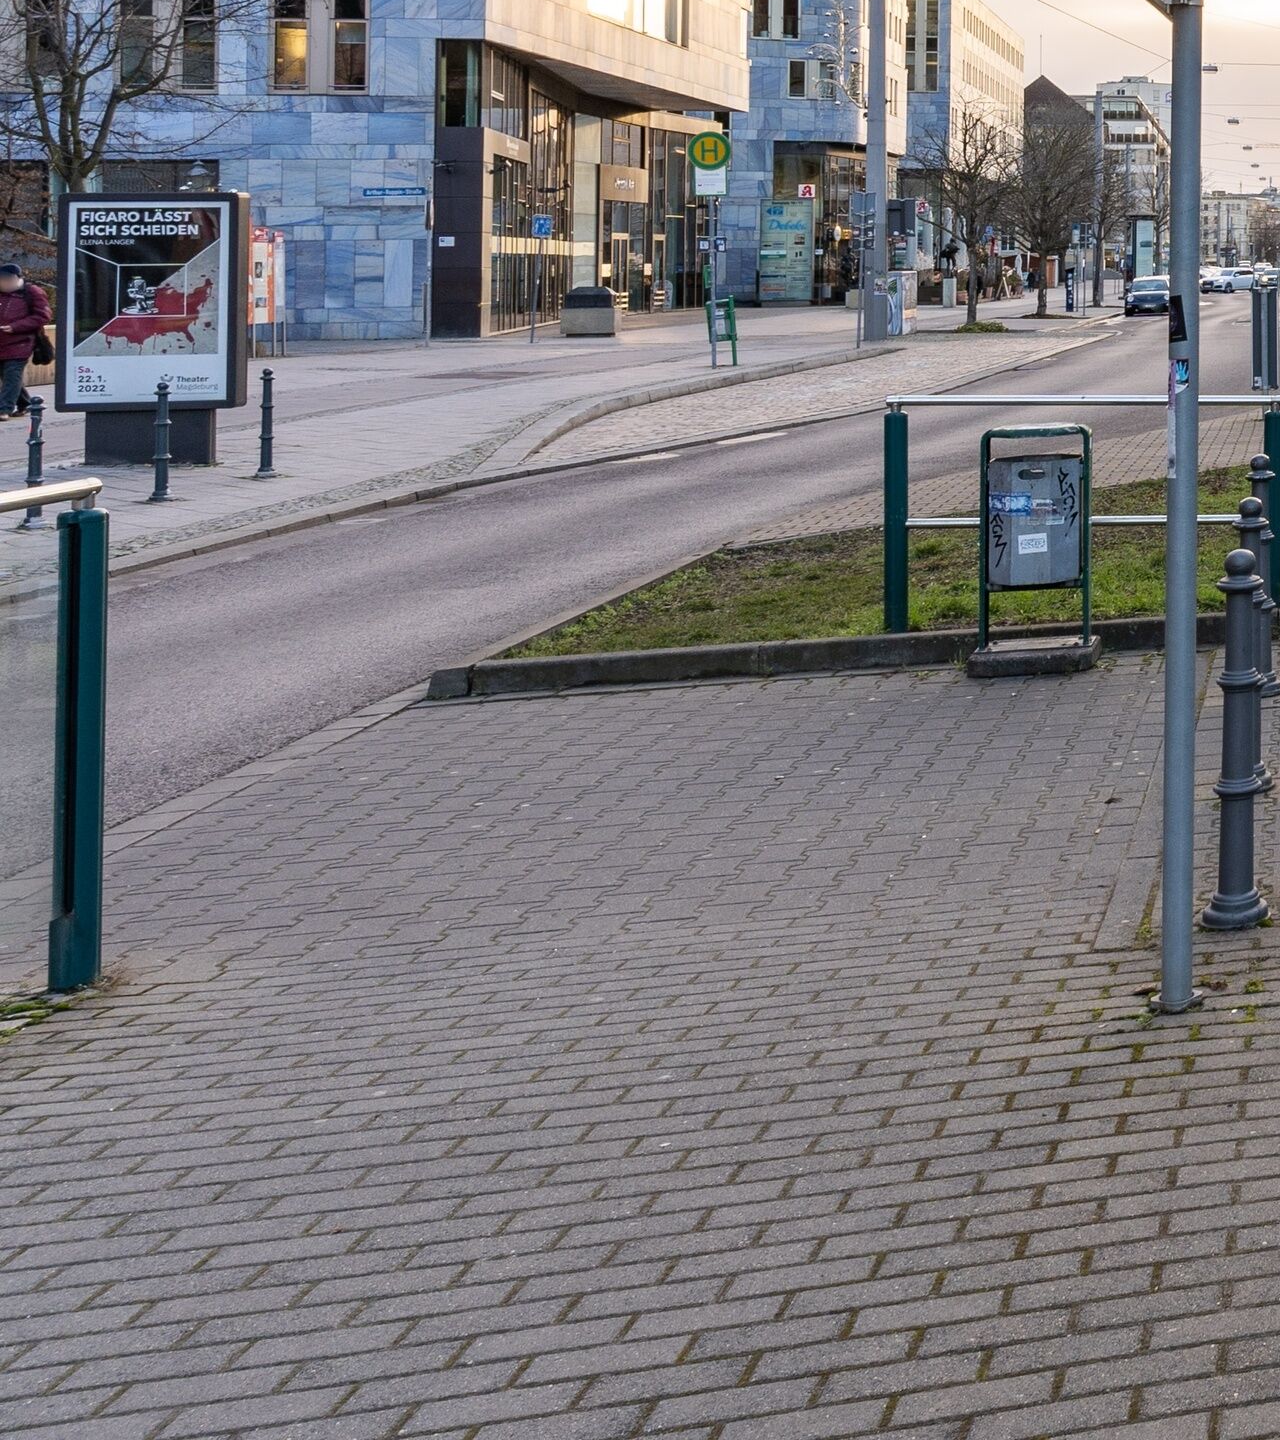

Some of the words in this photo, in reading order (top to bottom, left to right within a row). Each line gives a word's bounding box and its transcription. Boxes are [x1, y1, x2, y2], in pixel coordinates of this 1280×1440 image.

[701, 140, 718, 161] H
[80, 211, 140, 223] FIGARO
[143, 208, 192, 222] LÄSST
[79, 225, 117, 236] SICH
[120, 224, 199, 236] SCHEIDEN
[79, 238, 104, 246] ELENA
[105, 238, 135, 246] LANGER
[77, 365, 94, 374] Sa.
[176, 375, 209, 383] Theater
[77, 384, 106, 393] 2022
[176, 383, 219, 392] Magdeburg
